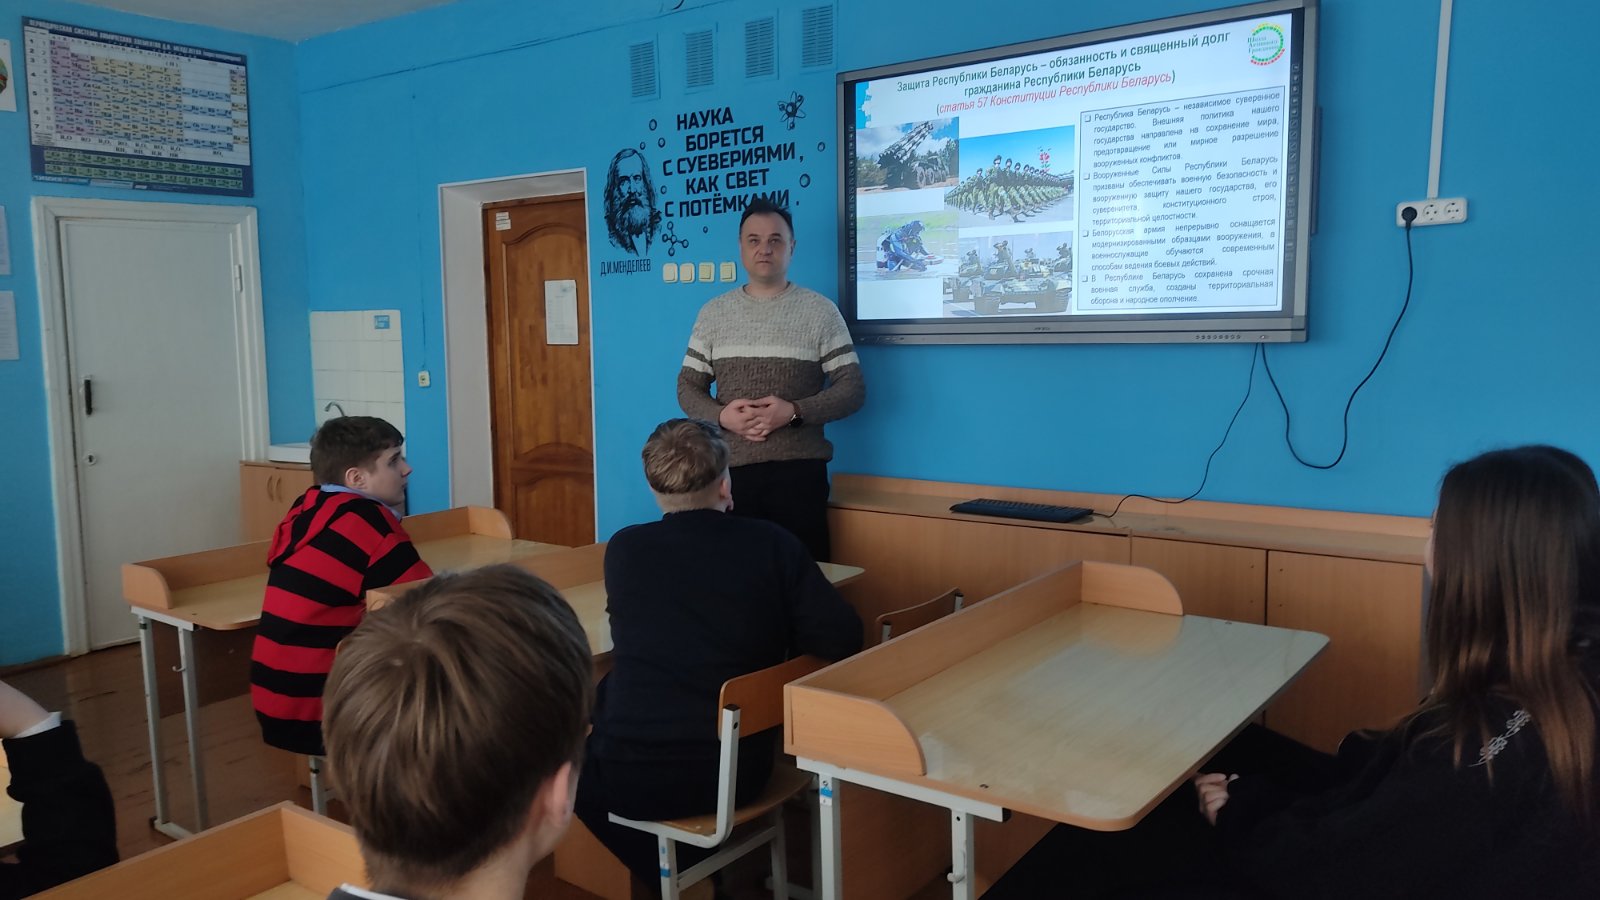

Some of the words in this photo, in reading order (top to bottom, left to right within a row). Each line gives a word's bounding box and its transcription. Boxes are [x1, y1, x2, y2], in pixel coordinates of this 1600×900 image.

[897, 80, 930, 92] Защита
[932, 69, 988, 86] Республики
[990, 63, 1038, 80] Беларусь
[1049, 48, 1117, 68] обязанность
[1120, 48, 1127, 58] и
[1130, 34, 1199, 56] священный
[1201, 32, 1231, 48] долг
[964, 78, 1021, 97] гражданина
[1024, 70, 1085, 89] Республики
[1088, 62, 1141, 80] Беларусь
[936, 100, 975, 116] (статья
[977, 97, 988, 108] 57
[990, 87, 1056, 106] Конституции
[1059, 80, 1119, 96] Республики
[1121, 69, 1175, 89] Беларусь)
[1094, 111, 1134, 121] Республика
[1137, 106, 1171, 116] Беларусь
[1184, 98, 1231, 110] независимое
[1236, 92, 1280, 105] суверенное
[1152, 117, 1184, 126] Внешняя
[1201, 110, 1234, 120] политика
[1252, 105, 1280, 114] нашего
[676, 106, 734, 131] НАУКА
[685, 124, 764, 152] БОРЕТСЯ
[1094, 134, 1134, 145] государства
[1141, 128, 1182, 139] направлена
[1206, 121, 1250, 132] сохранение
[1094, 144, 1150, 156] предотвращение
[1190, 137, 1218, 146] мирное
[1232, 130, 1279, 143] разрешение
[662, 159, 673, 176] С
[1093, 169, 1139, 180] Вооруженные
[1185, 161, 1227, 171] Республики
[1242, 156, 1278, 166] Беларусь
[686, 175, 720, 195] КАК
[726, 168, 770, 189] СВЕТ
[1093, 183, 1124, 192] призваны
[1129, 178, 1176, 188] обеспечивать
[1181, 174, 1212, 183] военную
[1217, 169, 1267, 180] безопасность
[1093, 193, 1137, 203] вооруженную
[1144, 190, 1169, 199] защиту
[1176, 187, 1202, 195] нашего
[1163, 197, 1227, 208] конституционного
[664, 202, 674, 218] С
[1092, 214, 1150, 226] территориальной
[1176, 222, 1219, 232] непрерывно
[1230, 219, 1276, 228] оснащается
[1172, 235, 1211, 244] образцами
[1092, 251, 1148, 260] военнослужащие
[1166, 248, 1204, 257] обучаются
[1222, 244, 1275, 253] современным
[1152, 272, 1185, 280] Беларусь
[1195, 270, 1232, 279] сохранена
[1243, 269, 1273, 277] срочная
[1208, 281, 1273, 290] территориальная
